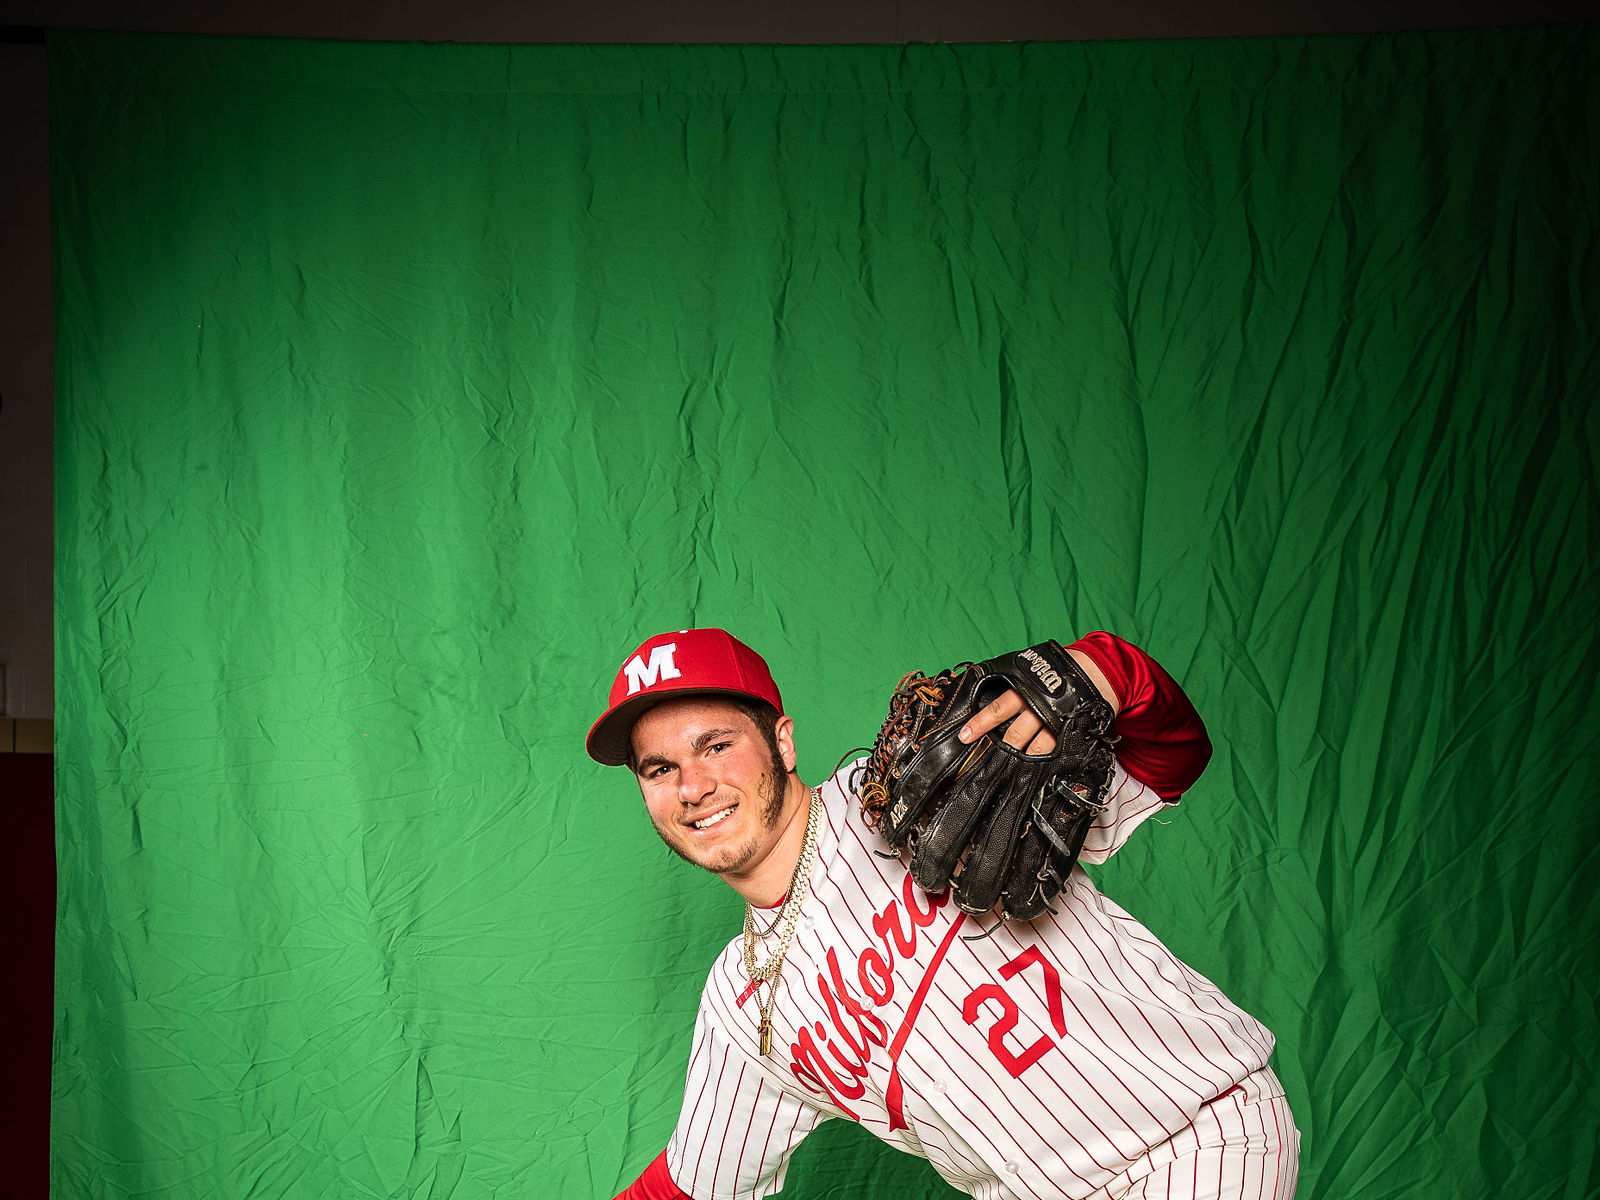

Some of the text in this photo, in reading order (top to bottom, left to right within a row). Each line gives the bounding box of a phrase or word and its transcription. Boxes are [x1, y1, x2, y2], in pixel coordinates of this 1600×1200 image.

[624, 642, 682, 696] M
[1017, 649, 1062, 693] Wilson
[963, 944, 1067, 1079] 27
